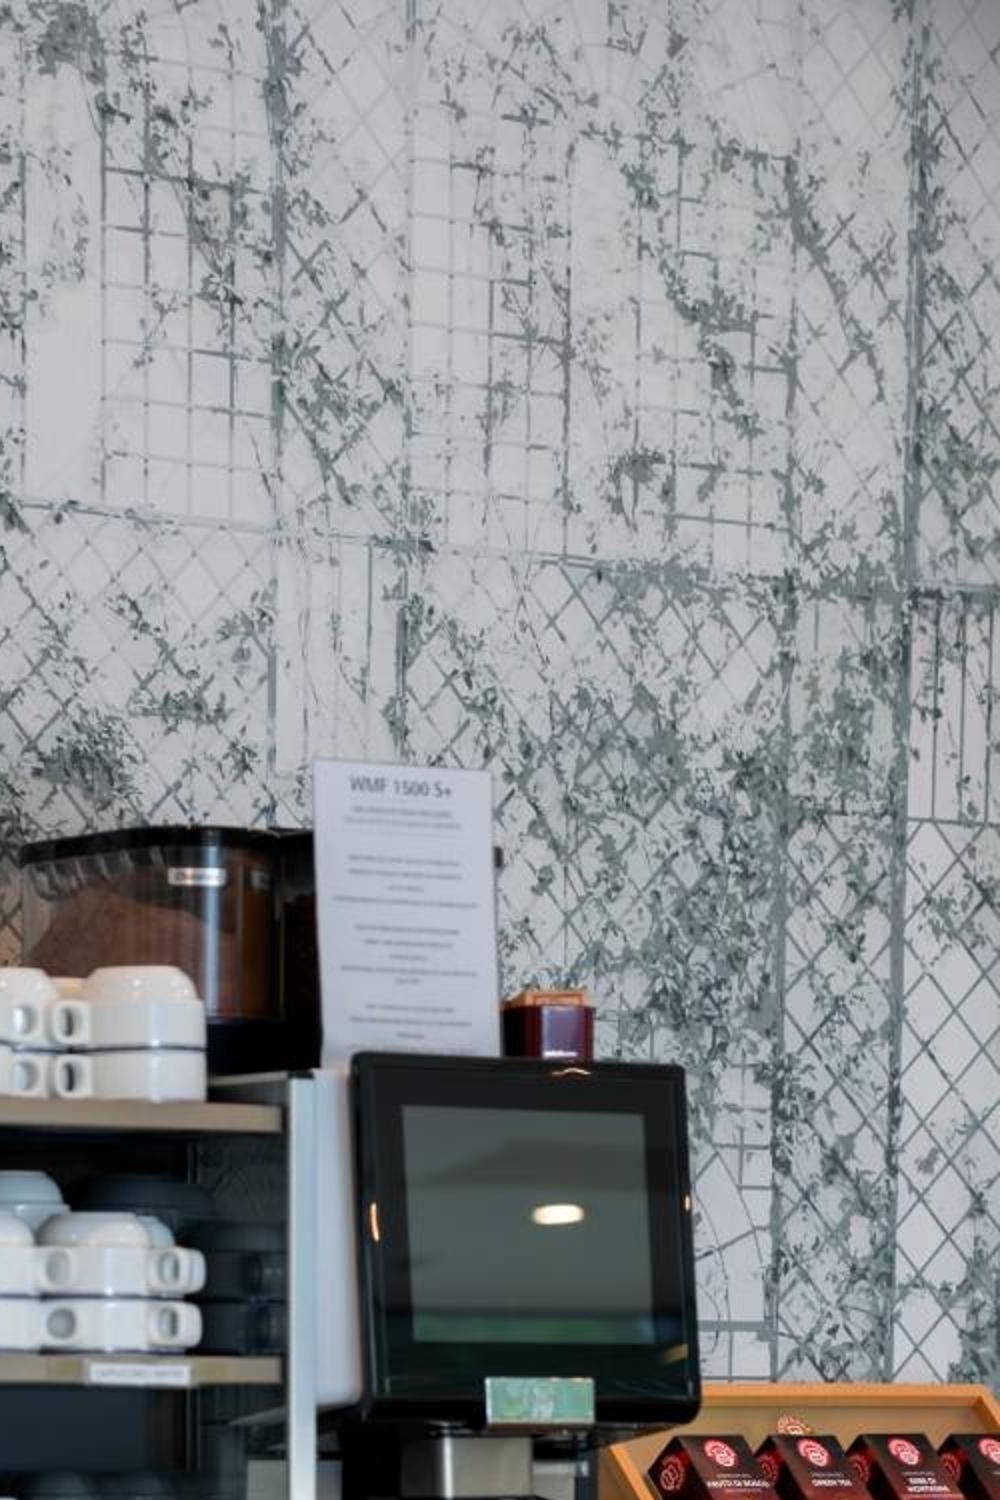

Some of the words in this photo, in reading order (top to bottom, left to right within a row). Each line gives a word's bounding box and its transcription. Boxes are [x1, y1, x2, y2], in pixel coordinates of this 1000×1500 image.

[350, 776, 386, 793] WMF
[393, 779, 430, 798] 1500
[434, 780, 453, 799] S+
